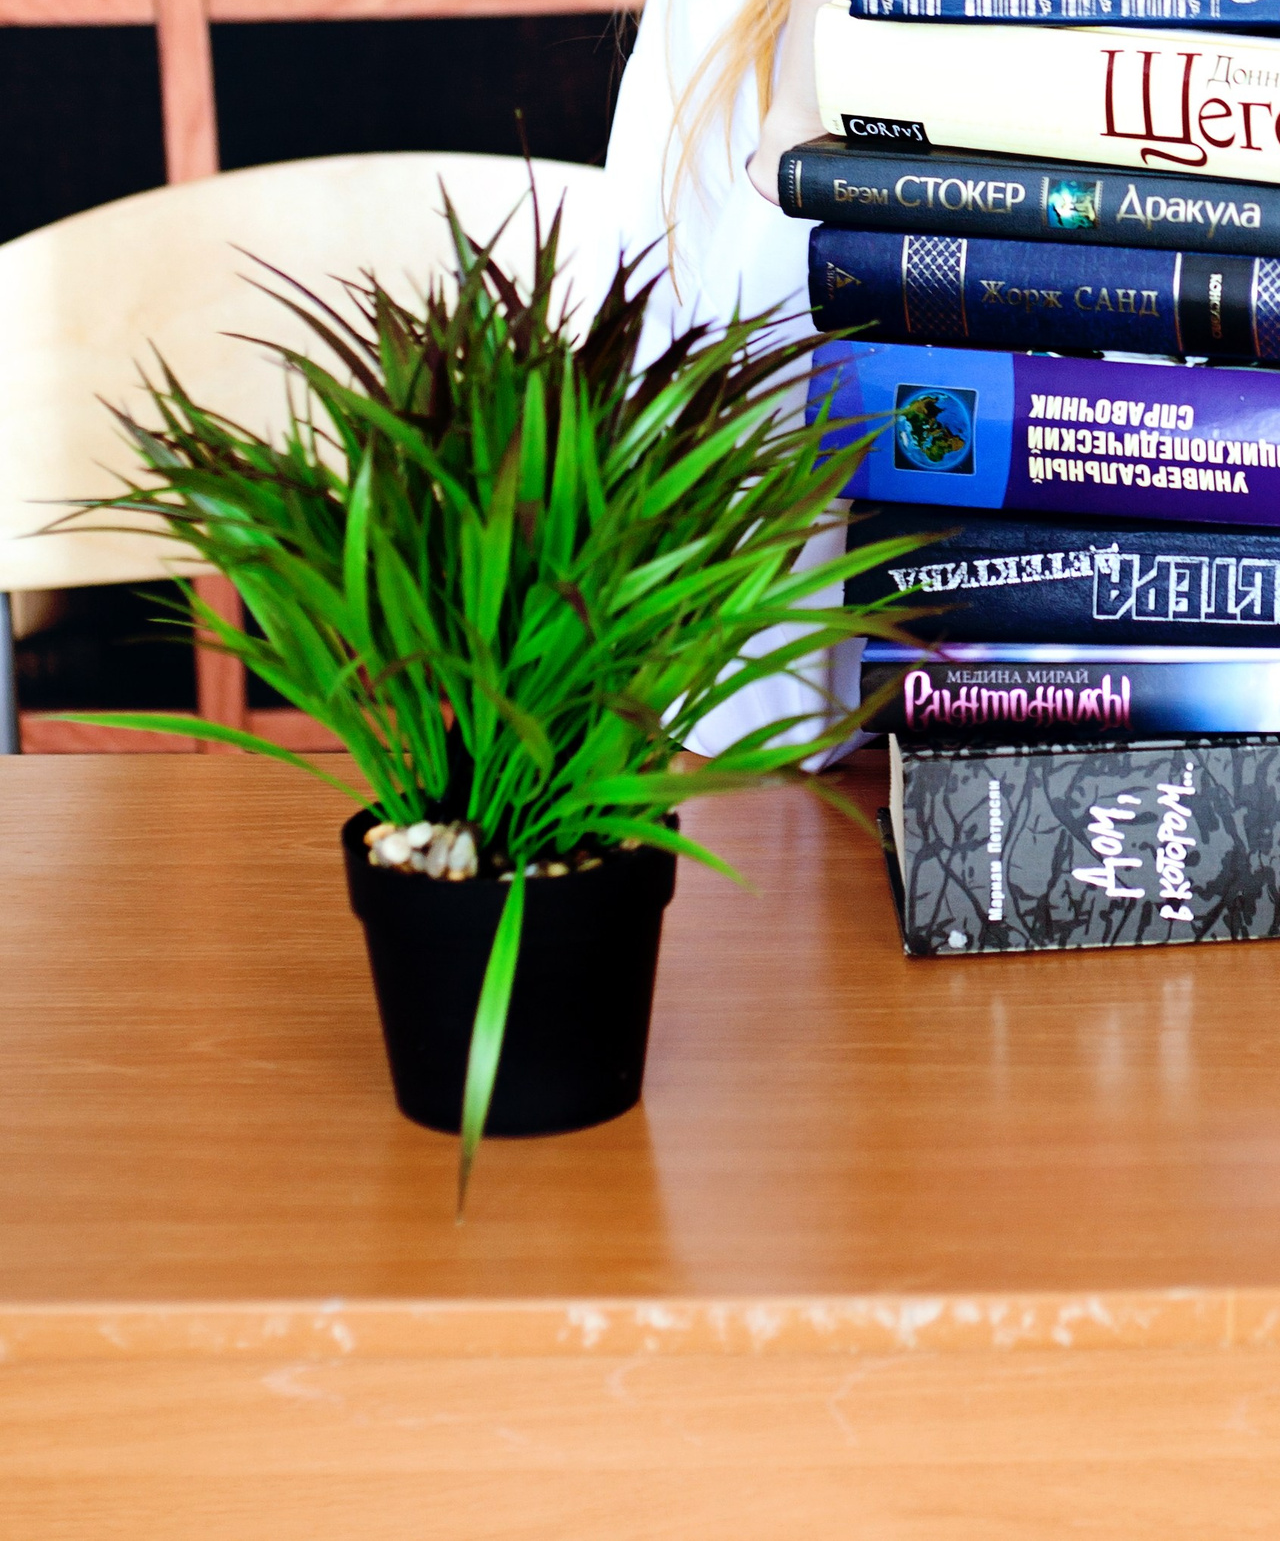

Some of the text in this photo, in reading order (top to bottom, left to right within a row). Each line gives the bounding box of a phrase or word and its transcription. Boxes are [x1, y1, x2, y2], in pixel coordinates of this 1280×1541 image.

[895, 174, 1026, 214] СТОКЕР
[1116, 184, 1261, 239] Дракула
[980, 279, 1161, 317] Жорж САНД
[1028, 394, 1194, 431] СПРАВОЧНИК
[1028, 455, 1249, 494] УНИВЕРСАЛЬНЫЙ
[888, 542, 1119, 594] ДЕТЕКТИВА
[946, 667, 1089, 684] МЕДИНА МИРАЙ
[987, 779, 1005, 921] Мариам Петросян
